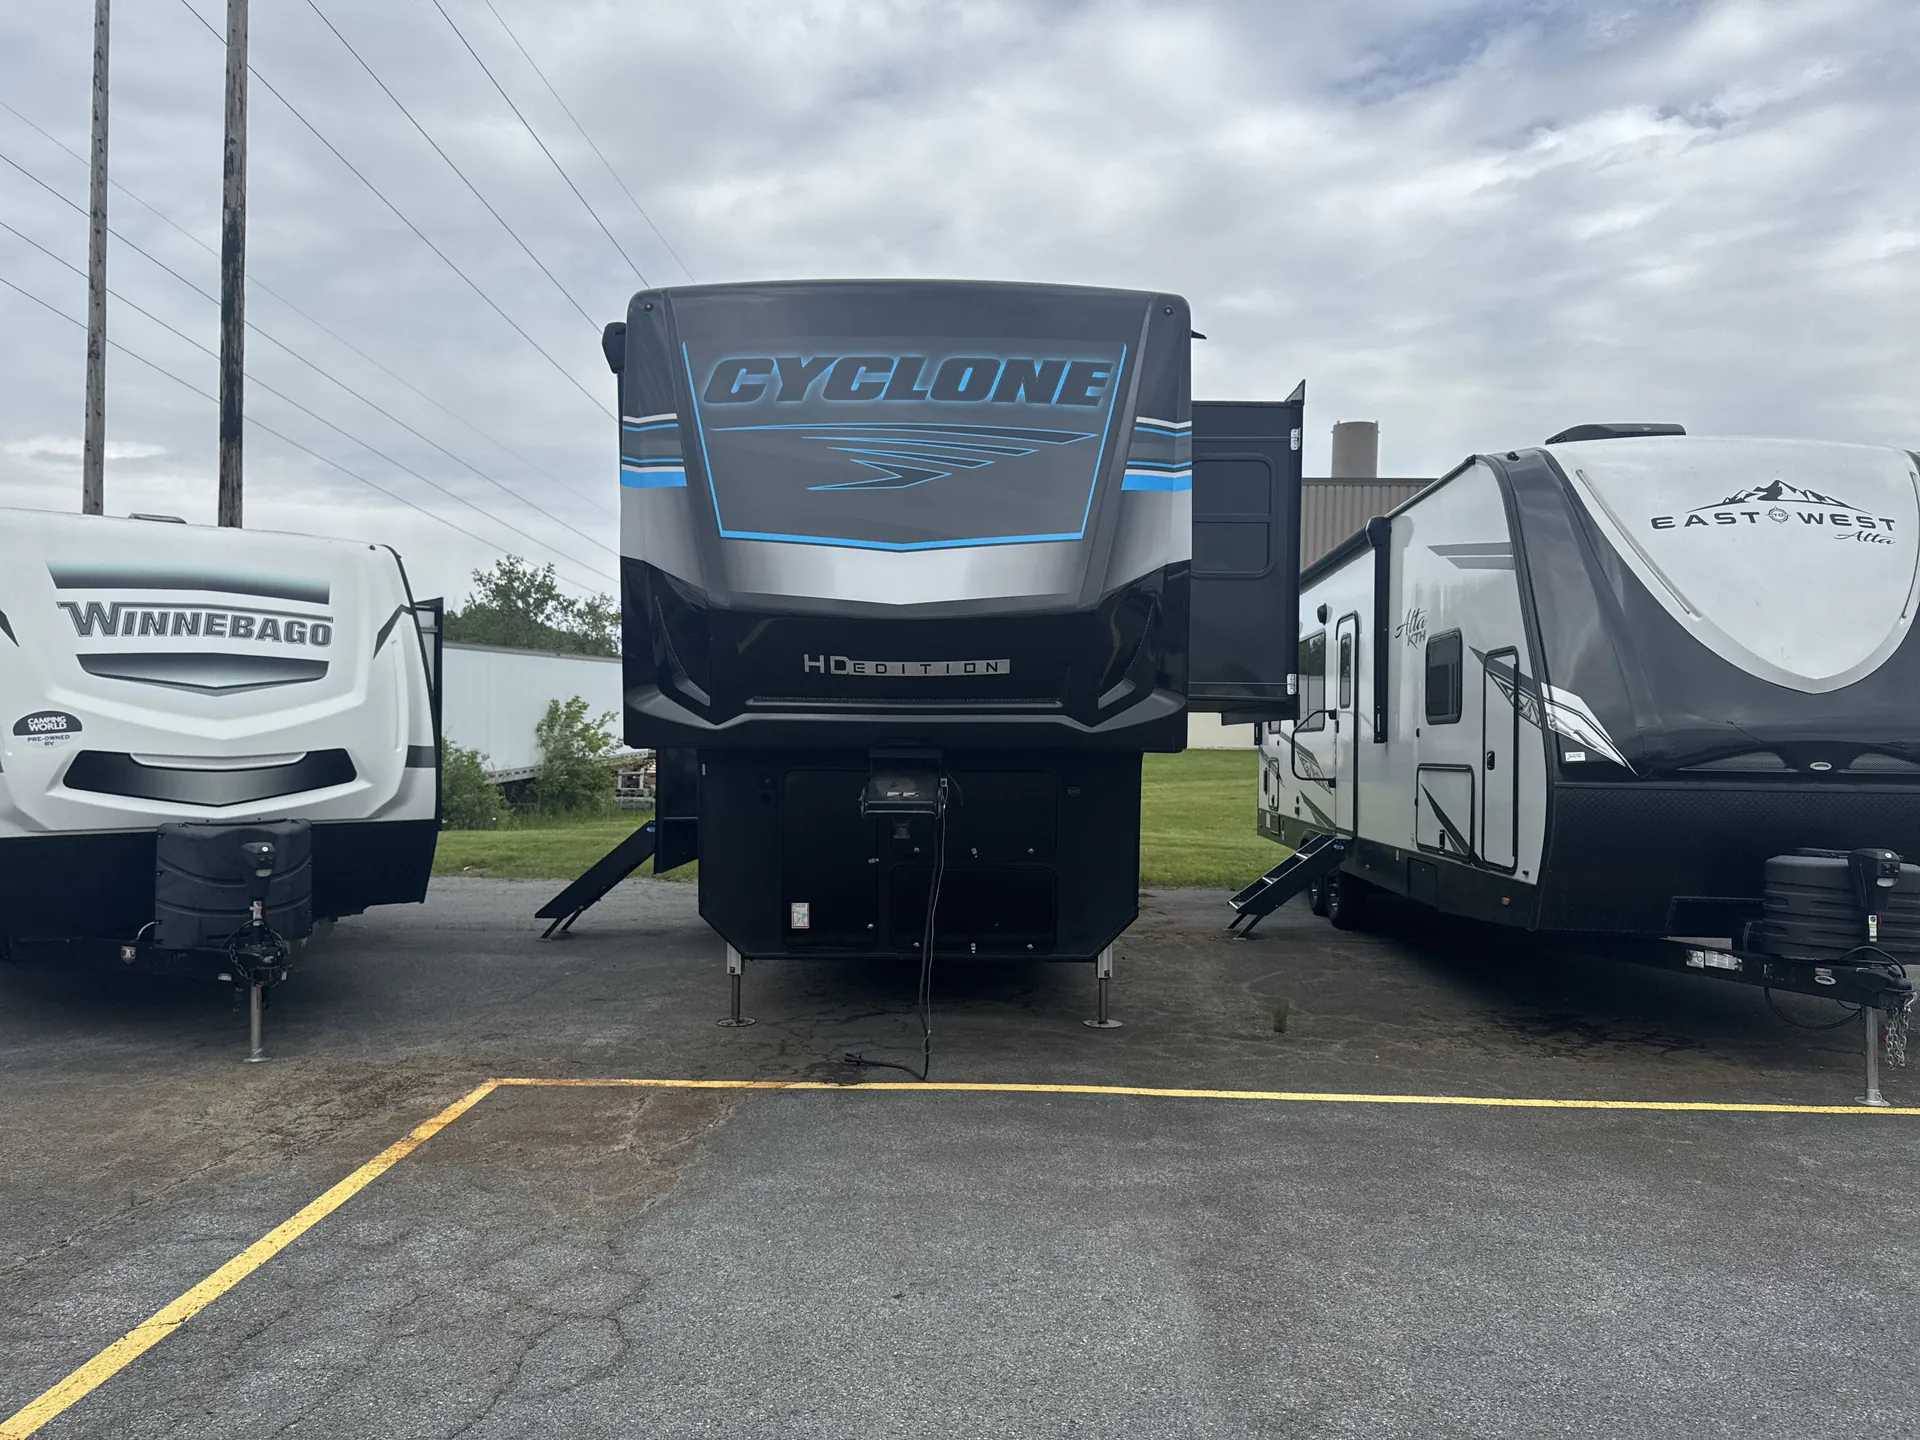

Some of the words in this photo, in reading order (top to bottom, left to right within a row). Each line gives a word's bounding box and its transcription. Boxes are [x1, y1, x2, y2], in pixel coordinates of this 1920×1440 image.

[703, 356, 1113, 407] CYCLONE
[1651, 511, 1760, 530] EAST
[1796, 511, 1896, 532] WEST
[1833, 530, 1896, 545] Alta
[56, 601, 334, 647] WINNEBAGO
[1395, 608, 1428, 639] Alta
[1407, 629, 1426, 650] KTH
[27, 716, 67, 725] CAMPING
[28, 722, 67, 732] WORLD
[27, 734, 70, 742] PRE-OWNED
